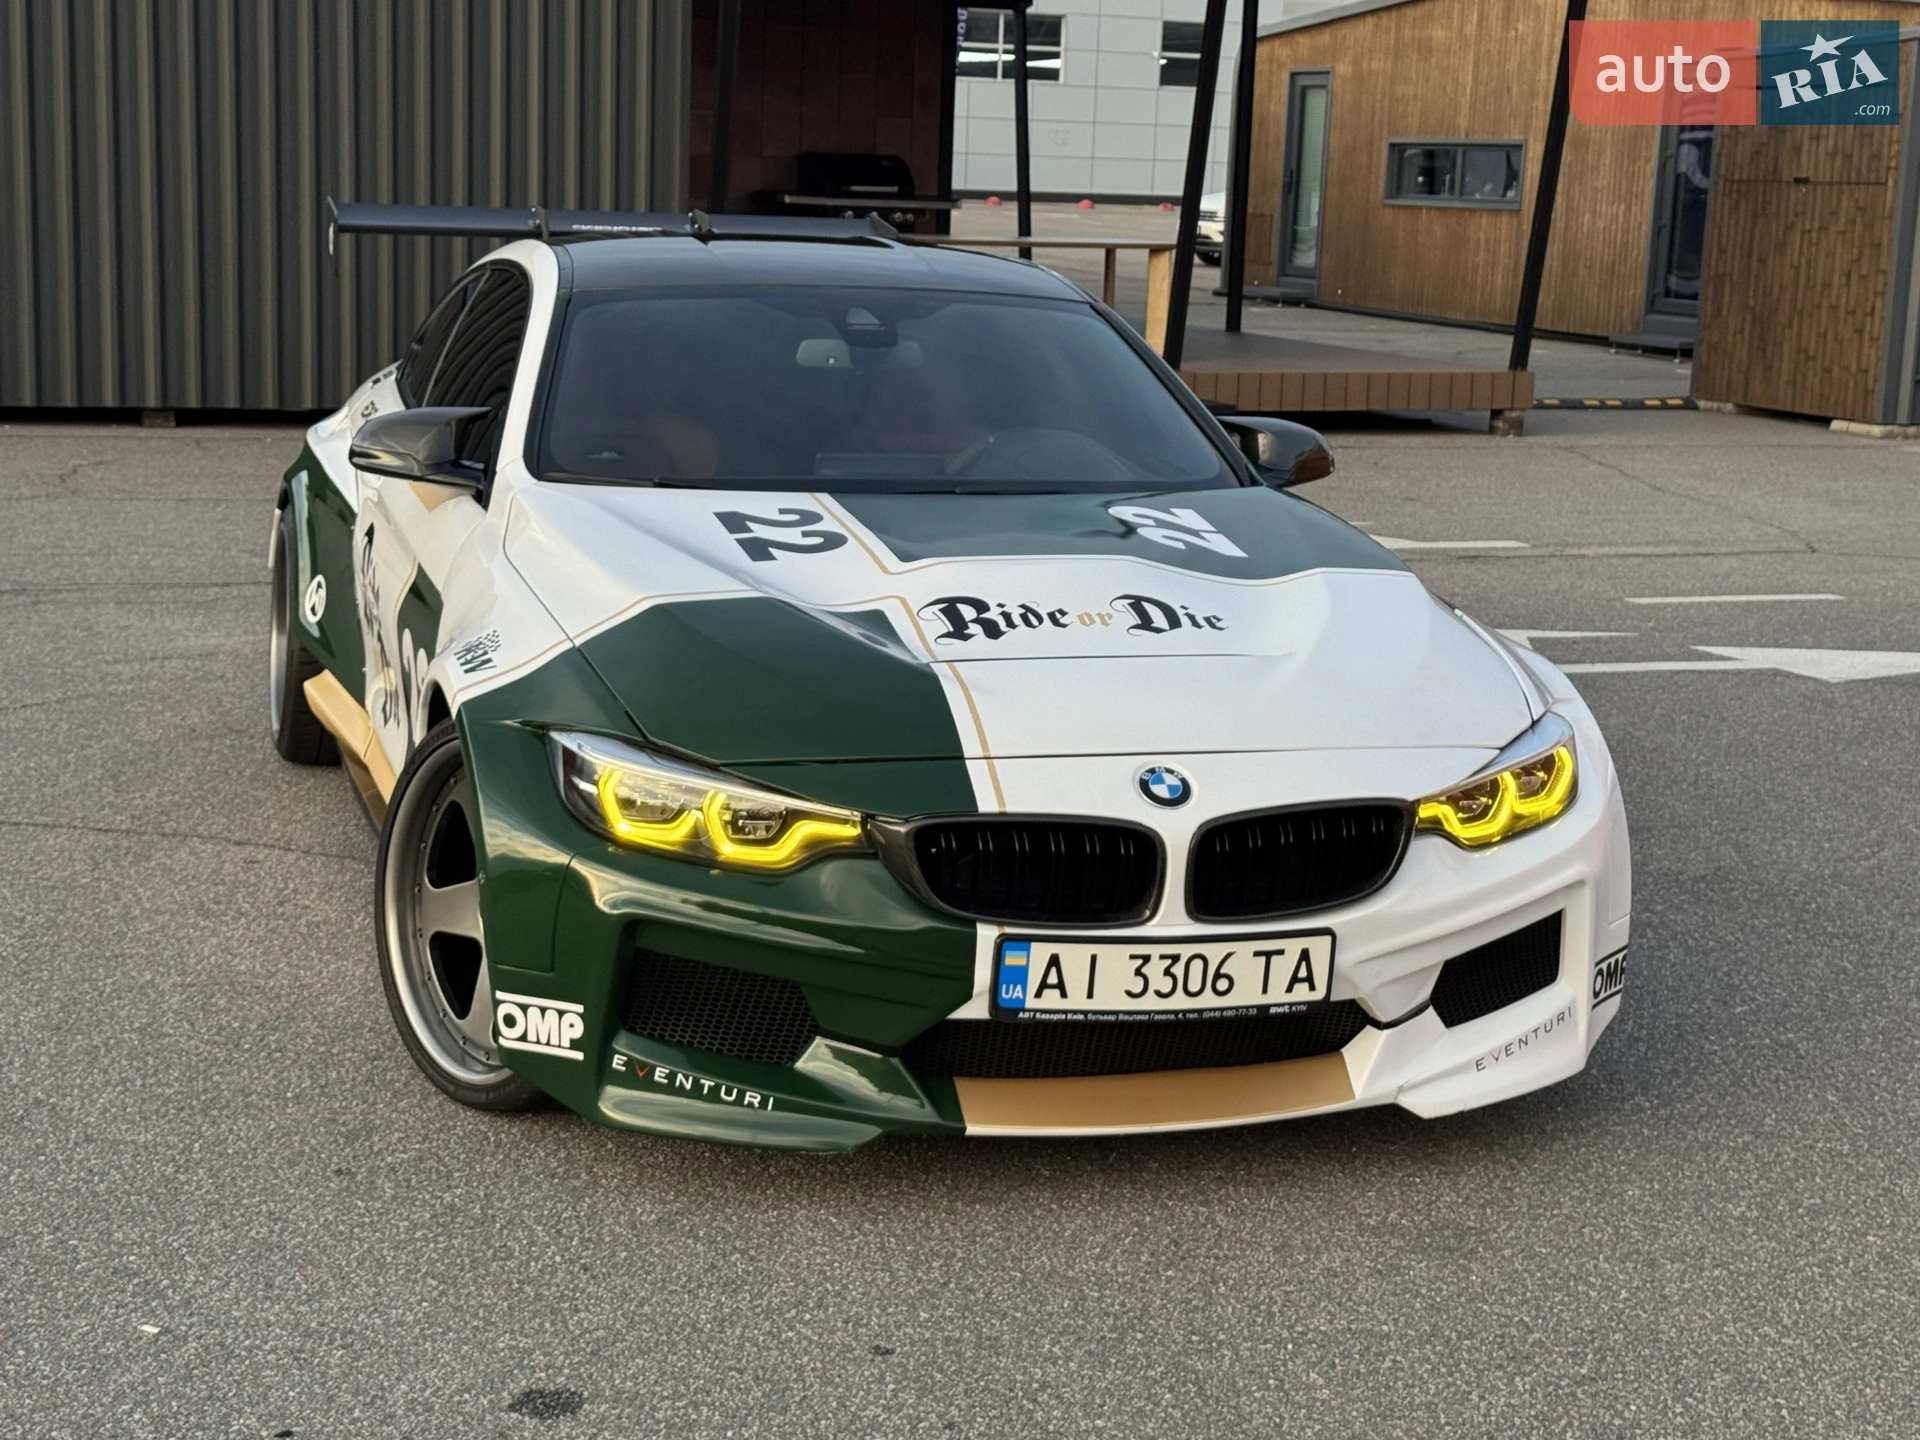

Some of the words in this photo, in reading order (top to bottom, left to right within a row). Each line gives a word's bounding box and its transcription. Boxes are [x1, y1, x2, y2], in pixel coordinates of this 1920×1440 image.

[712, 507, 849, 562] 22
[1107, 505, 1249, 558] 22
[917, 595, 1073, 646] Ride
[1076, 609, 1114, 628] or
[1110, 593, 1229, 637] Die
[1141, 766, 1184, 780] BMW
[1001, 983, 1024, 1000] UA
[1033, 953, 1098, 999] AI
[1124, 951, 1237, 999] 3306
[1252, 947, 1317, 995] TA
[496, 1002, 584, 1048] OMP
[1203, 1010, 1221, 1019] (044)
[1222, 1007, 1257, 1017] 490-77-33
[1475, 1007, 1572, 1073] EVENTURI
[612, 1054, 775, 1111] EVENTURI
